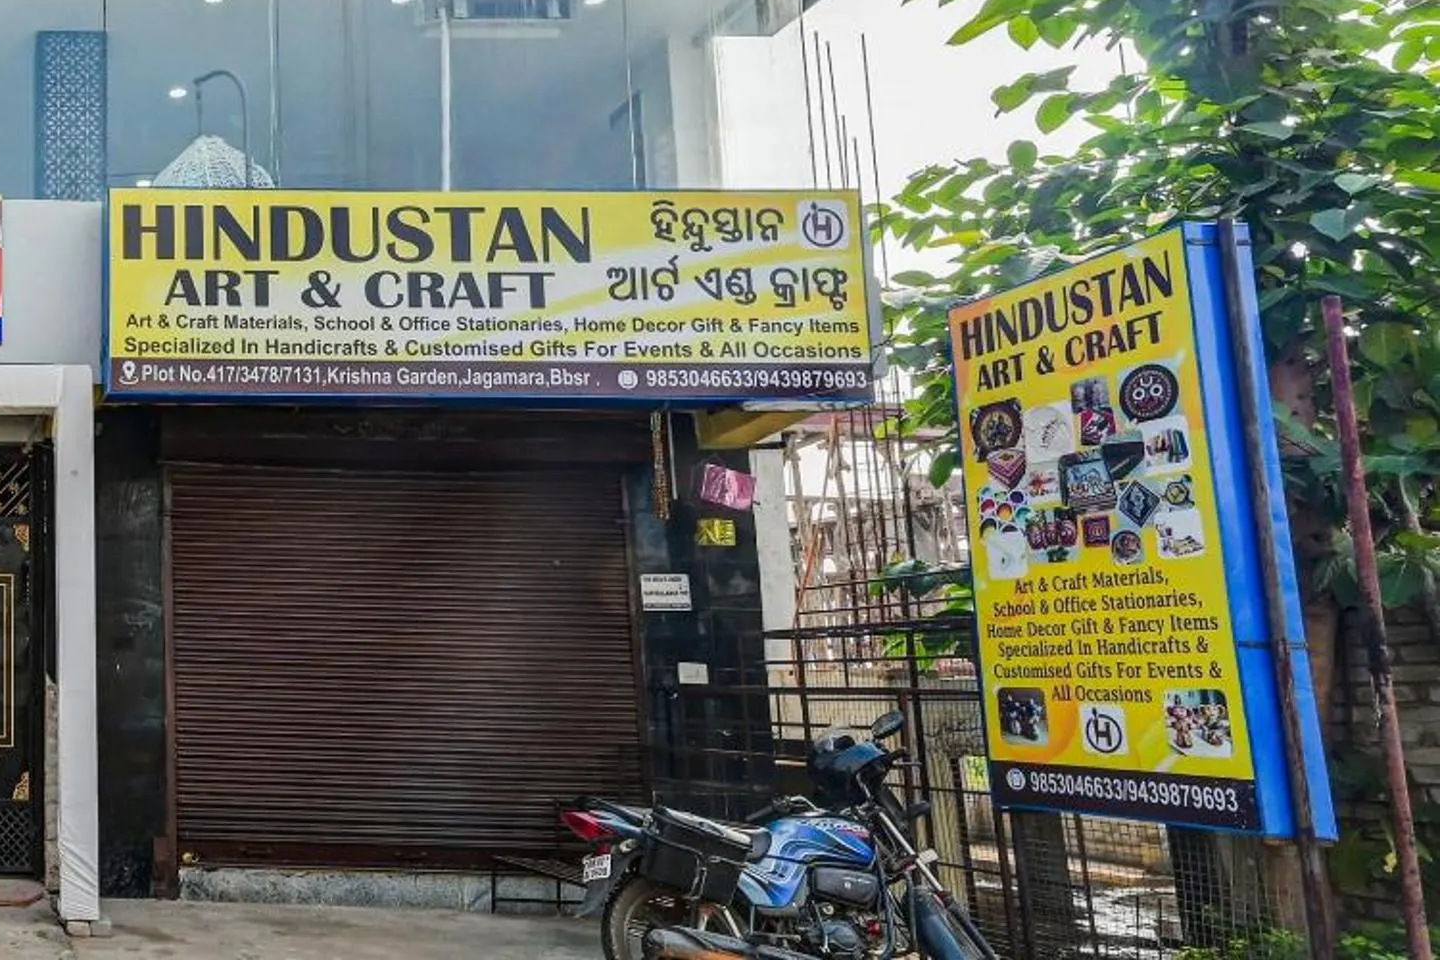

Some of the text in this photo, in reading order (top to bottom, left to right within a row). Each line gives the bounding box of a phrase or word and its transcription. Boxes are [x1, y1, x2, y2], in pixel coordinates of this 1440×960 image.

[122, 205, 591, 264] HINDUSTAN
[164, 269, 555, 309] ART & CRAFT
[960, 250, 1174, 361] HINDUSTAN
[126, 314, 860, 337] Art & Craft Materials, School & Office Stationaries, Home Decor Gift & Fancy Items
[124, 337, 862, 359] Specialized In Handicrafts & Customised Gifts For Events & All Occasions
[976, 310, 1163, 392] ART & CRAFT
[141, 364, 175, 381] Plot
[1015, 567, 1169, 594] Art & Craft Materials,
[994, 589, 1203, 617] School & Office Stationaries,
[987, 614, 1219, 638] Home Decor Gift & Fancy Items
[997, 636, 1209, 660] Specialized In Handicrafts &
[994, 662, 1223, 679] Customised Gifts For Events &
[1051, 685, 1153, 703] All Occasions
